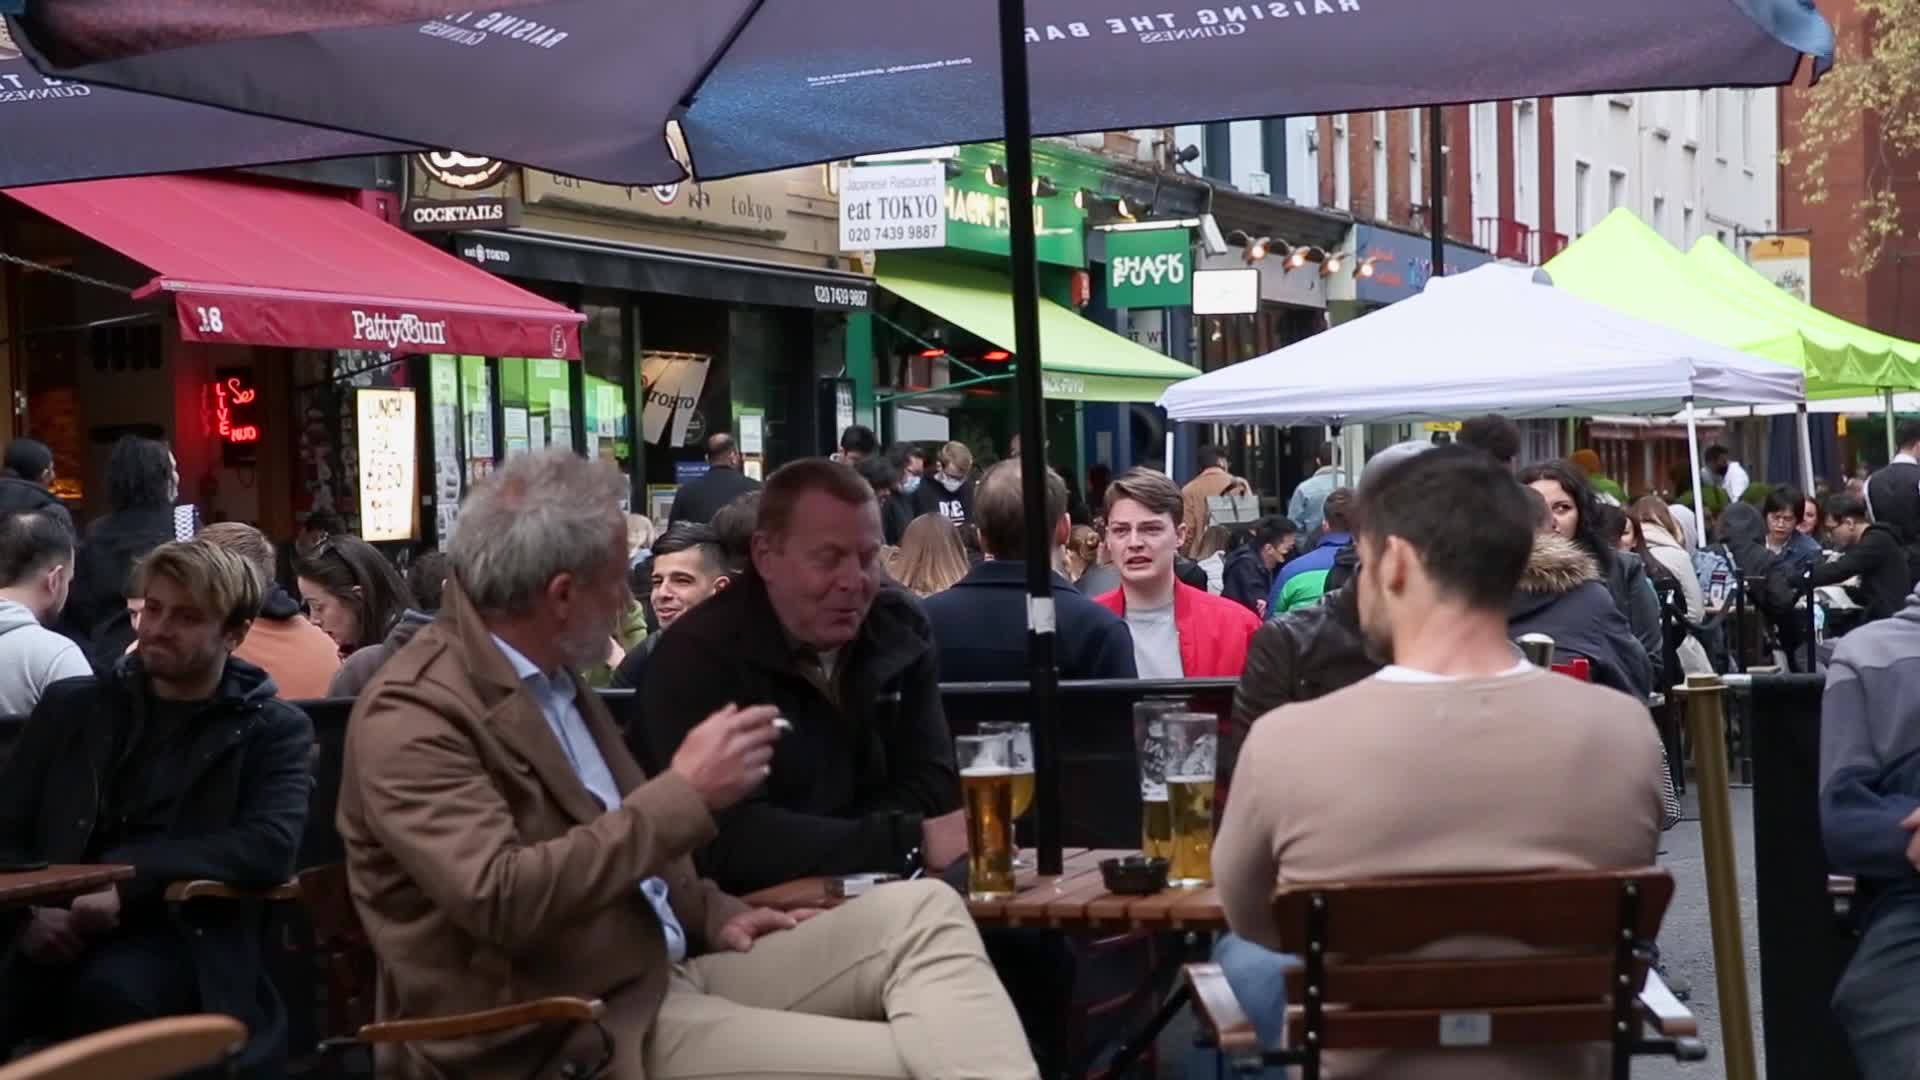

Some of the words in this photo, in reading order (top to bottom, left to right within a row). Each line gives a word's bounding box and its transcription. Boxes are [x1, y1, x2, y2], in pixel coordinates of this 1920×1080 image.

[413, 204, 503, 222] COCKTAILS
[731, 197, 773, 223] tokyo
[847, 200, 872, 220] eat
[879, 194, 937, 220] TOKYO
[944, 184, 991, 228] HACK
[848, 228, 871, 242] 020
[875, 226, 904, 240] 7439
[908, 225, 937, 239] 9887
[1113, 252, 1183, 277] SHACK
[1113, 262, 1184, 287] FUYU
[814, 285, 830, 303] 020
[830, 287, 849, 304] 7439
[197, 306, 223, 332] 18
[352, 310, 446, 348] Patty&Bun
[216, 382, 230, 435] LIVE
